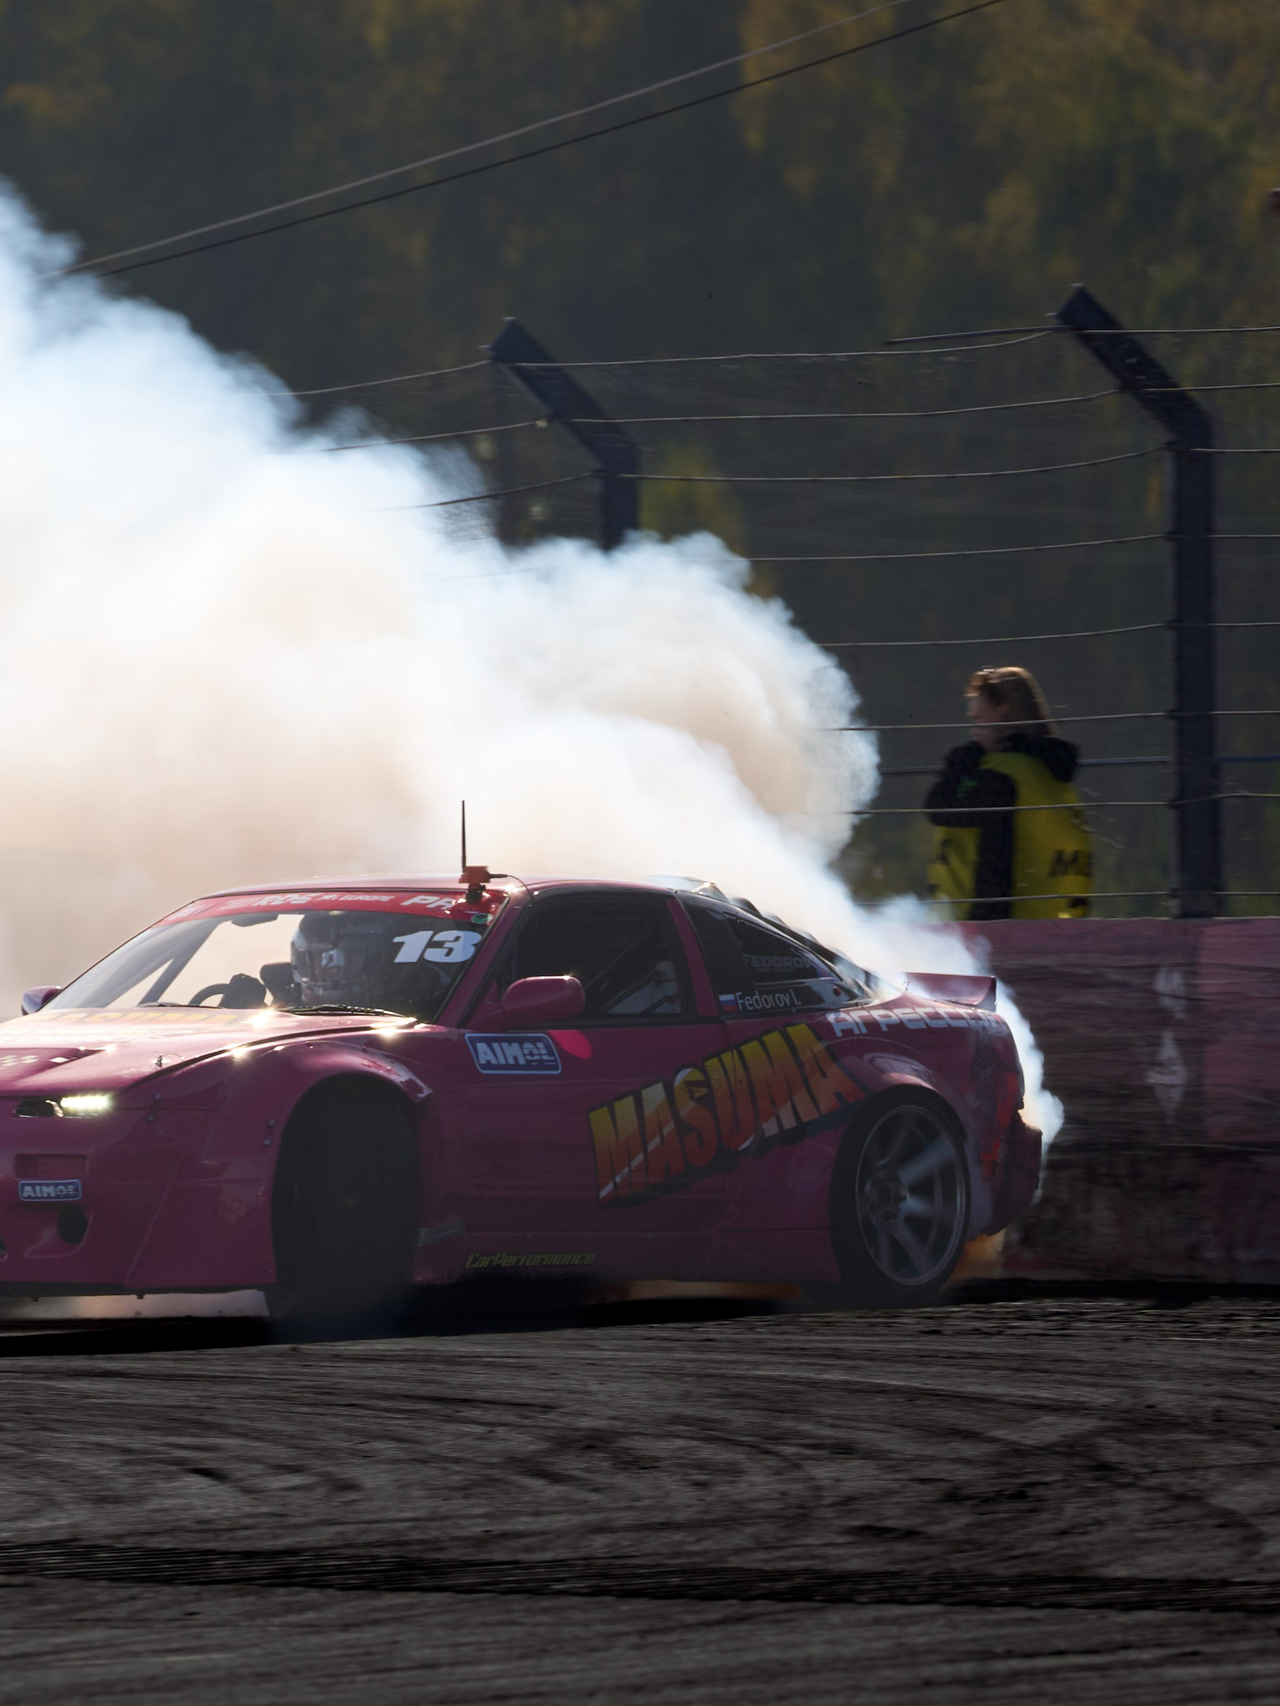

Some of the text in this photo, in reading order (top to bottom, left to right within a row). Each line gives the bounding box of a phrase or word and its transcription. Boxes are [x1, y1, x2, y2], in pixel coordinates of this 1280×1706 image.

[393, 930, 483, 963] 13
[736, 988, 789, 1011] Fedorov
[588, 1023, 866, 1202] MASUMA
